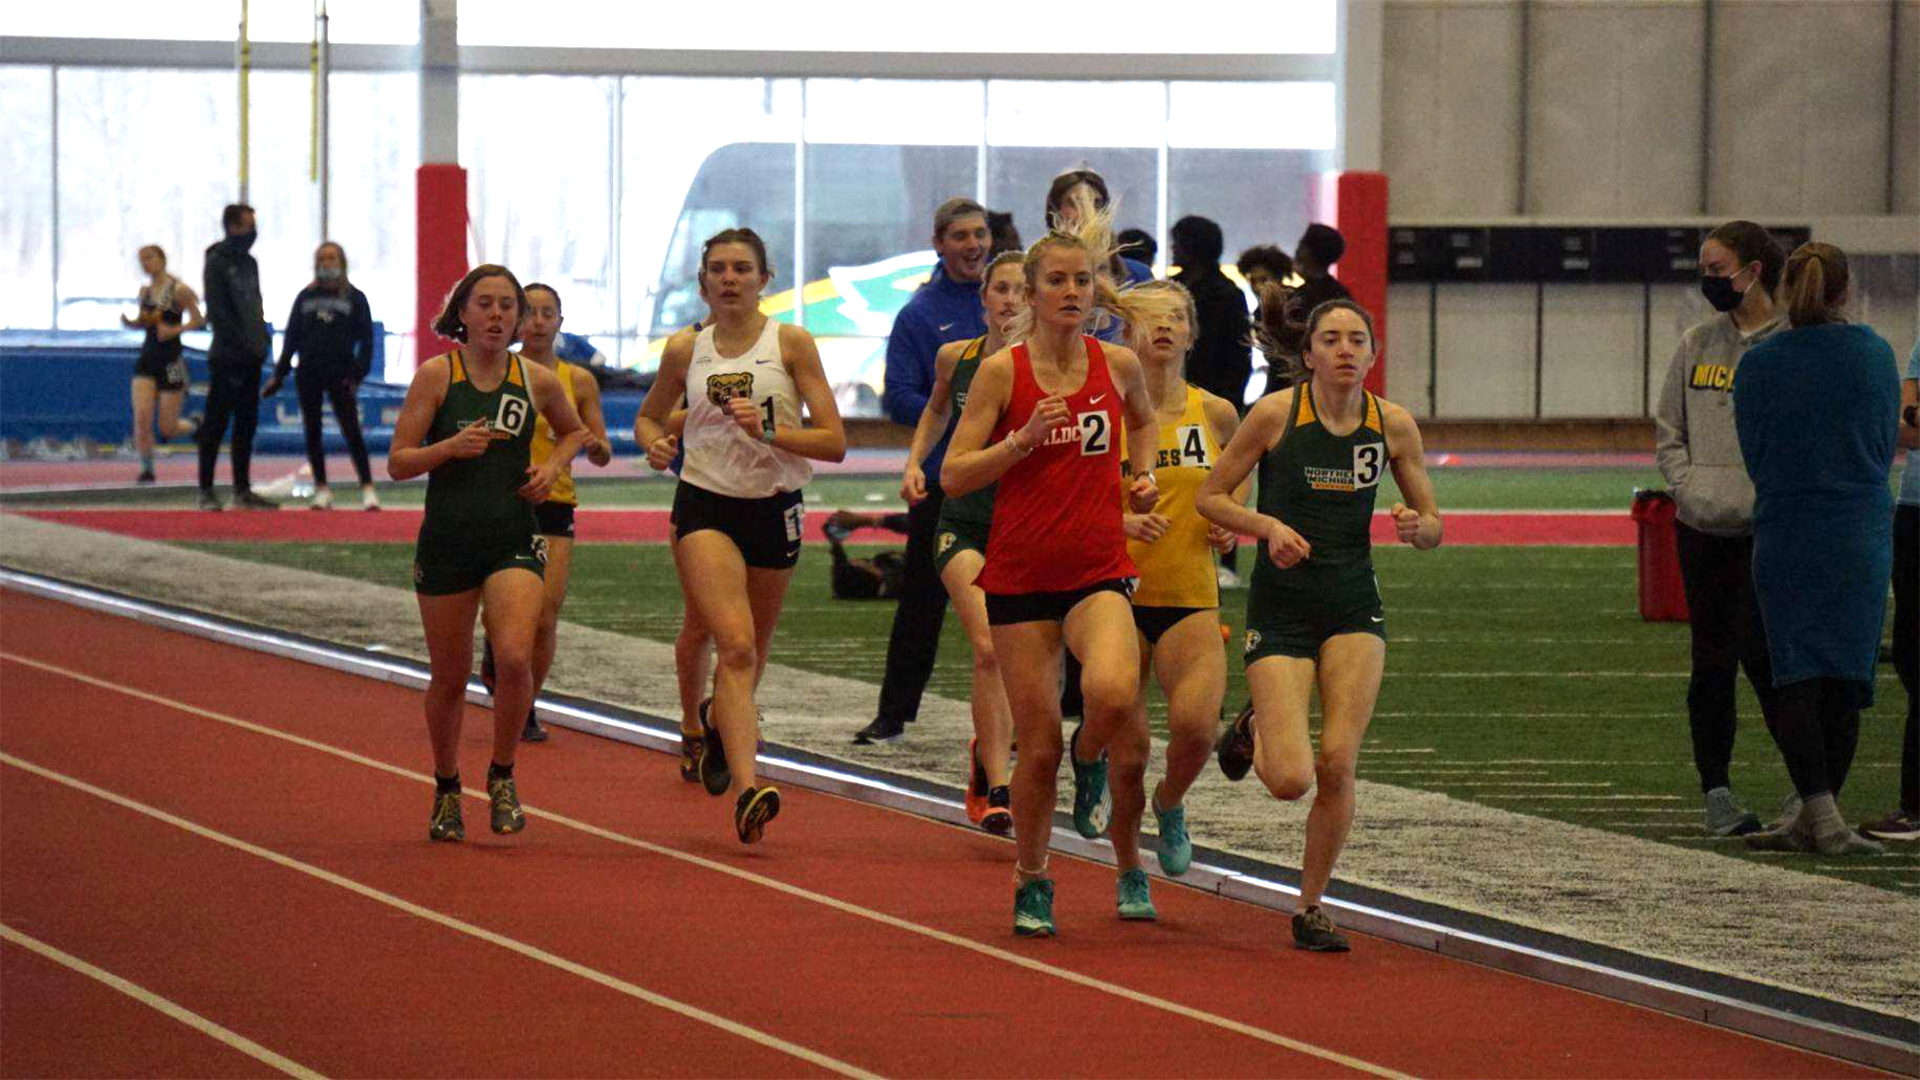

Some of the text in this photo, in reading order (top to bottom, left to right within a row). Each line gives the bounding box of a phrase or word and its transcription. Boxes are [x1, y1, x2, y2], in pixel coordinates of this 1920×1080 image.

[502, 399, 524, 430] 6
[761, 396, 775, 432] 1
[1083, 414, 1106, 452] 2
[1184, 428, 1205, 463] 4
[1358, 446, 1378, 484] 3
[788, 508, 800, 537] 1
